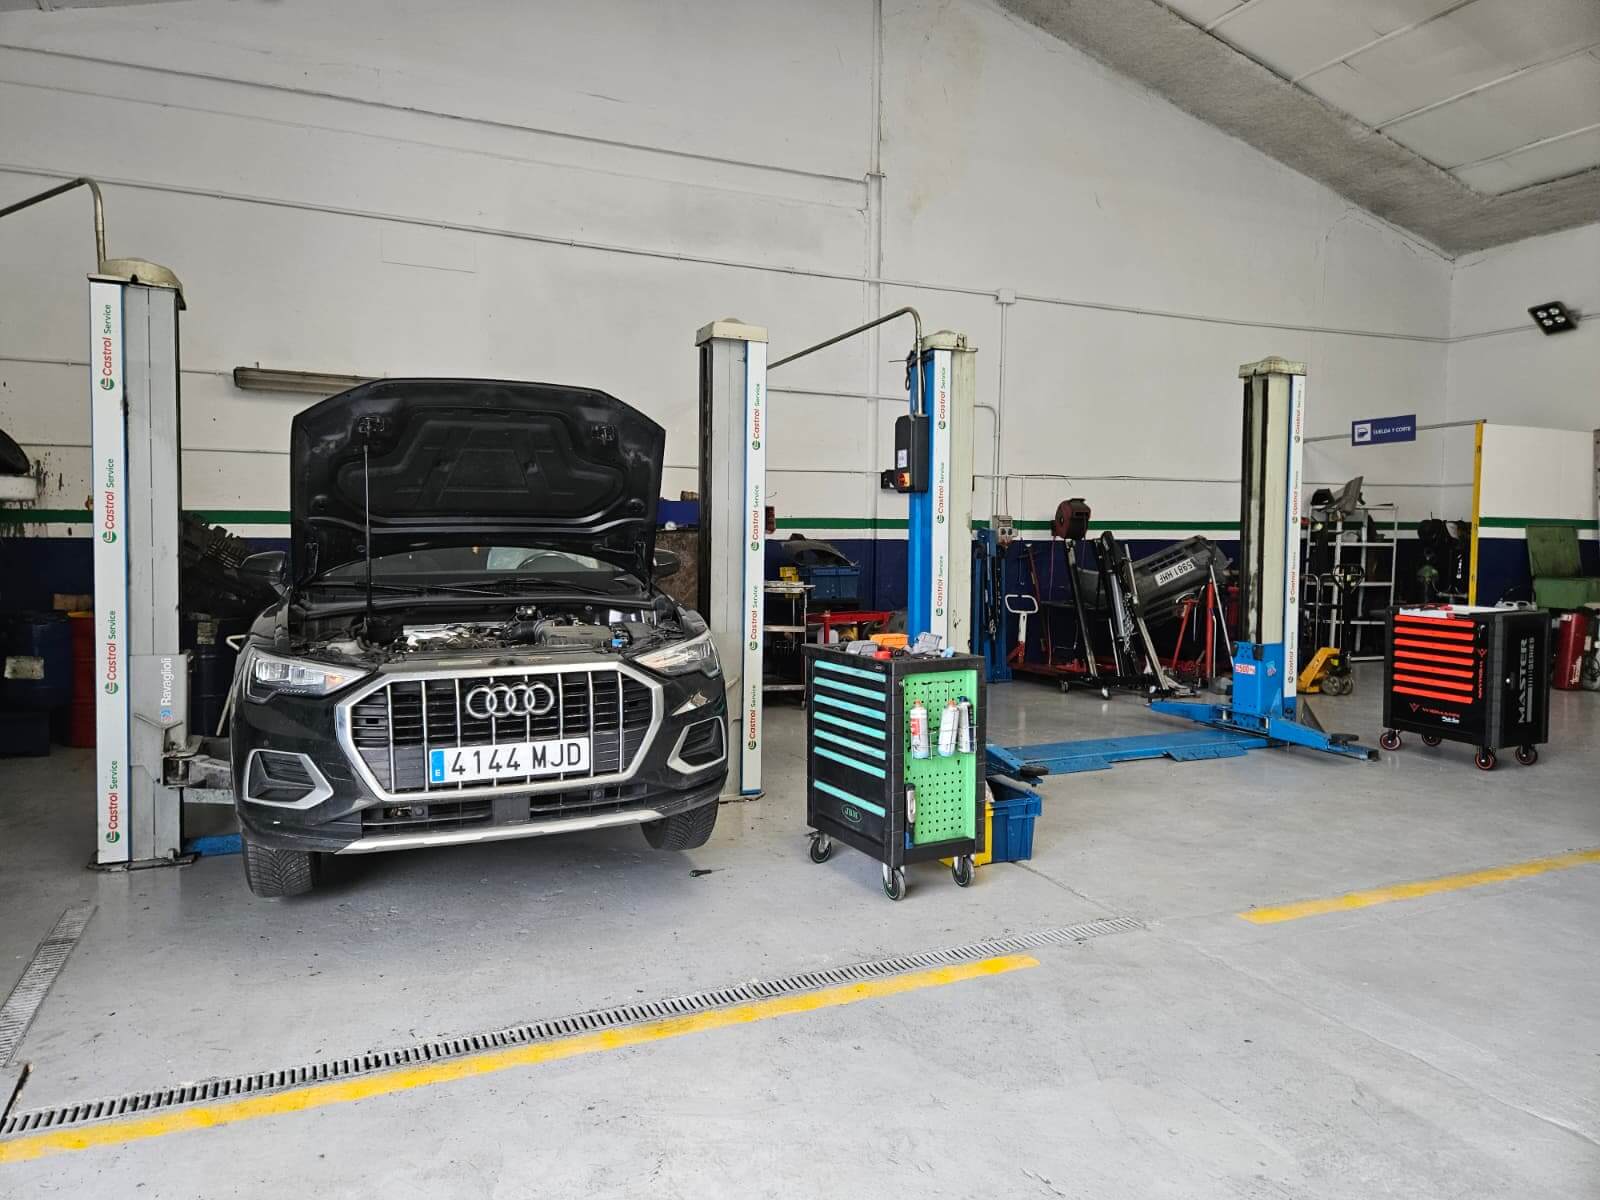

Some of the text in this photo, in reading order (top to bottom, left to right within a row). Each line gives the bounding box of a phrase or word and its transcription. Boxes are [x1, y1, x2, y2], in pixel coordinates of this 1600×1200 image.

[102, 304, 112, 376] Castrol Service
[105, 458, 115, 529] Castrol Service
[106, 610, 117, 681] Castrol Service
[161, 657, 174, 706] Ravaglioli
[1518, 639, 1527, 723] MASTER
[435, 769, 441, 777] E
[451, 743, 581, 775] 4144 MJD
[108, 760, 118, 830] Castrol Service
